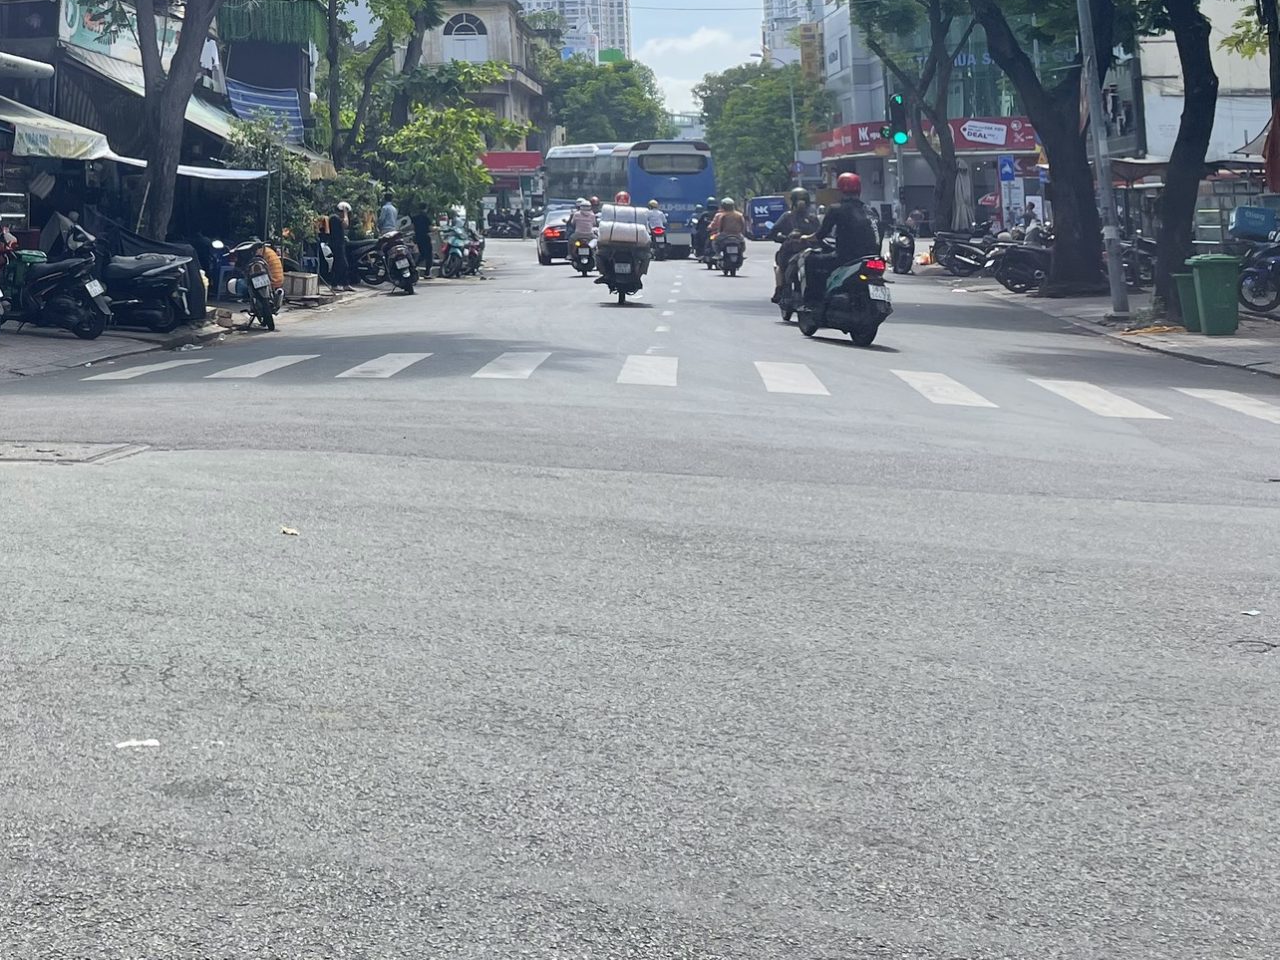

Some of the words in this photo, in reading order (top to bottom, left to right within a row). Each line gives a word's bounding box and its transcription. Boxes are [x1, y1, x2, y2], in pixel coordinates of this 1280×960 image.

[858, 126, 870, 142] NK
[967, 131, 988, 139] DEAL
[754, 205, 769, 214] NK
